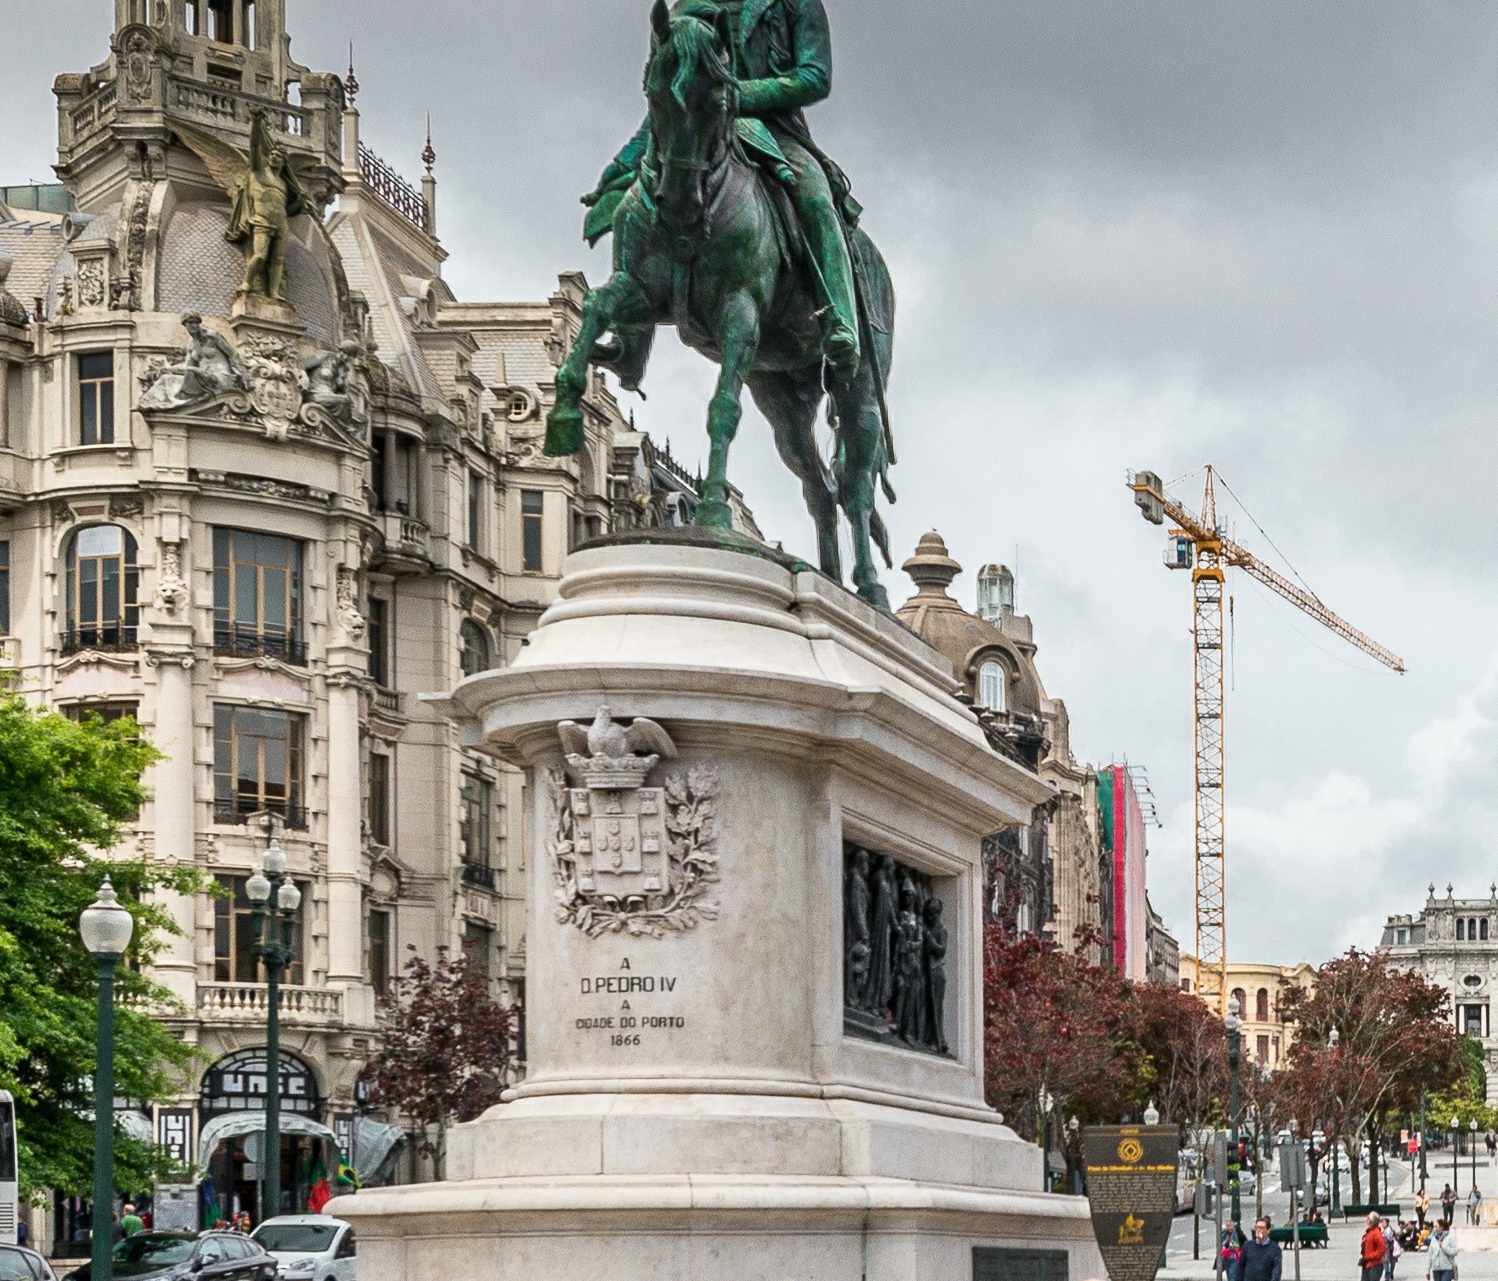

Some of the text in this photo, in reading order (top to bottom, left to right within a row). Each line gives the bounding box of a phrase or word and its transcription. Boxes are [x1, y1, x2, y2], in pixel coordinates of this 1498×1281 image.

[620, 957, 631, 970] A
[660, 976, 677, 992] IV
[621, 1000, 631, 1010] A
[576, 1016, 685, 1030] CIDADE DO PORTO
[610, 1034, 641, 1047] 1866
